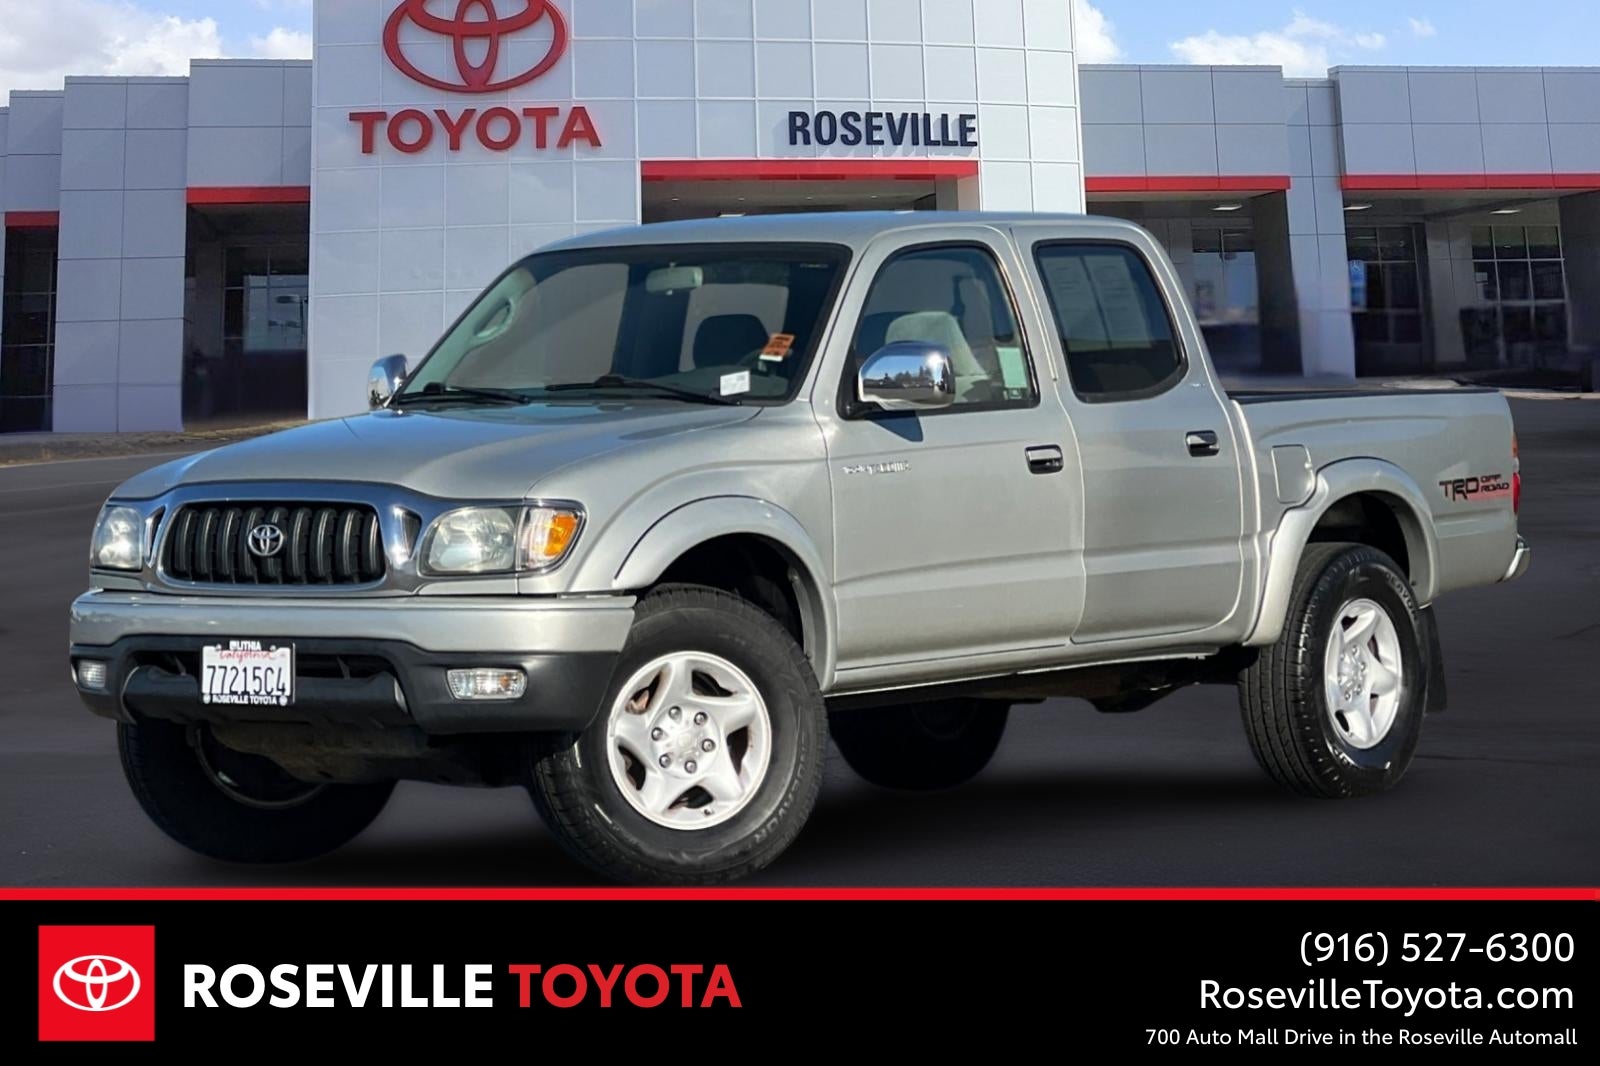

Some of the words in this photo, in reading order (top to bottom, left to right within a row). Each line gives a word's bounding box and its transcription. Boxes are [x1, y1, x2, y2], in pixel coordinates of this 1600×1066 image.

[349, 106, 602, 153] TOYOTA
[788, 111, 978, 147] ROSEVILLE
[1439, 477, 1479, 501] TRD
[1480, 474, 1501, 483] OFF
[1481, 482, 1510, 492] ROAD
[206, 665, 286, 695] 77215C4
[212, 694, 248, 704] ROSEVILLE
[250, 695, 276, 705] TOYOTA
